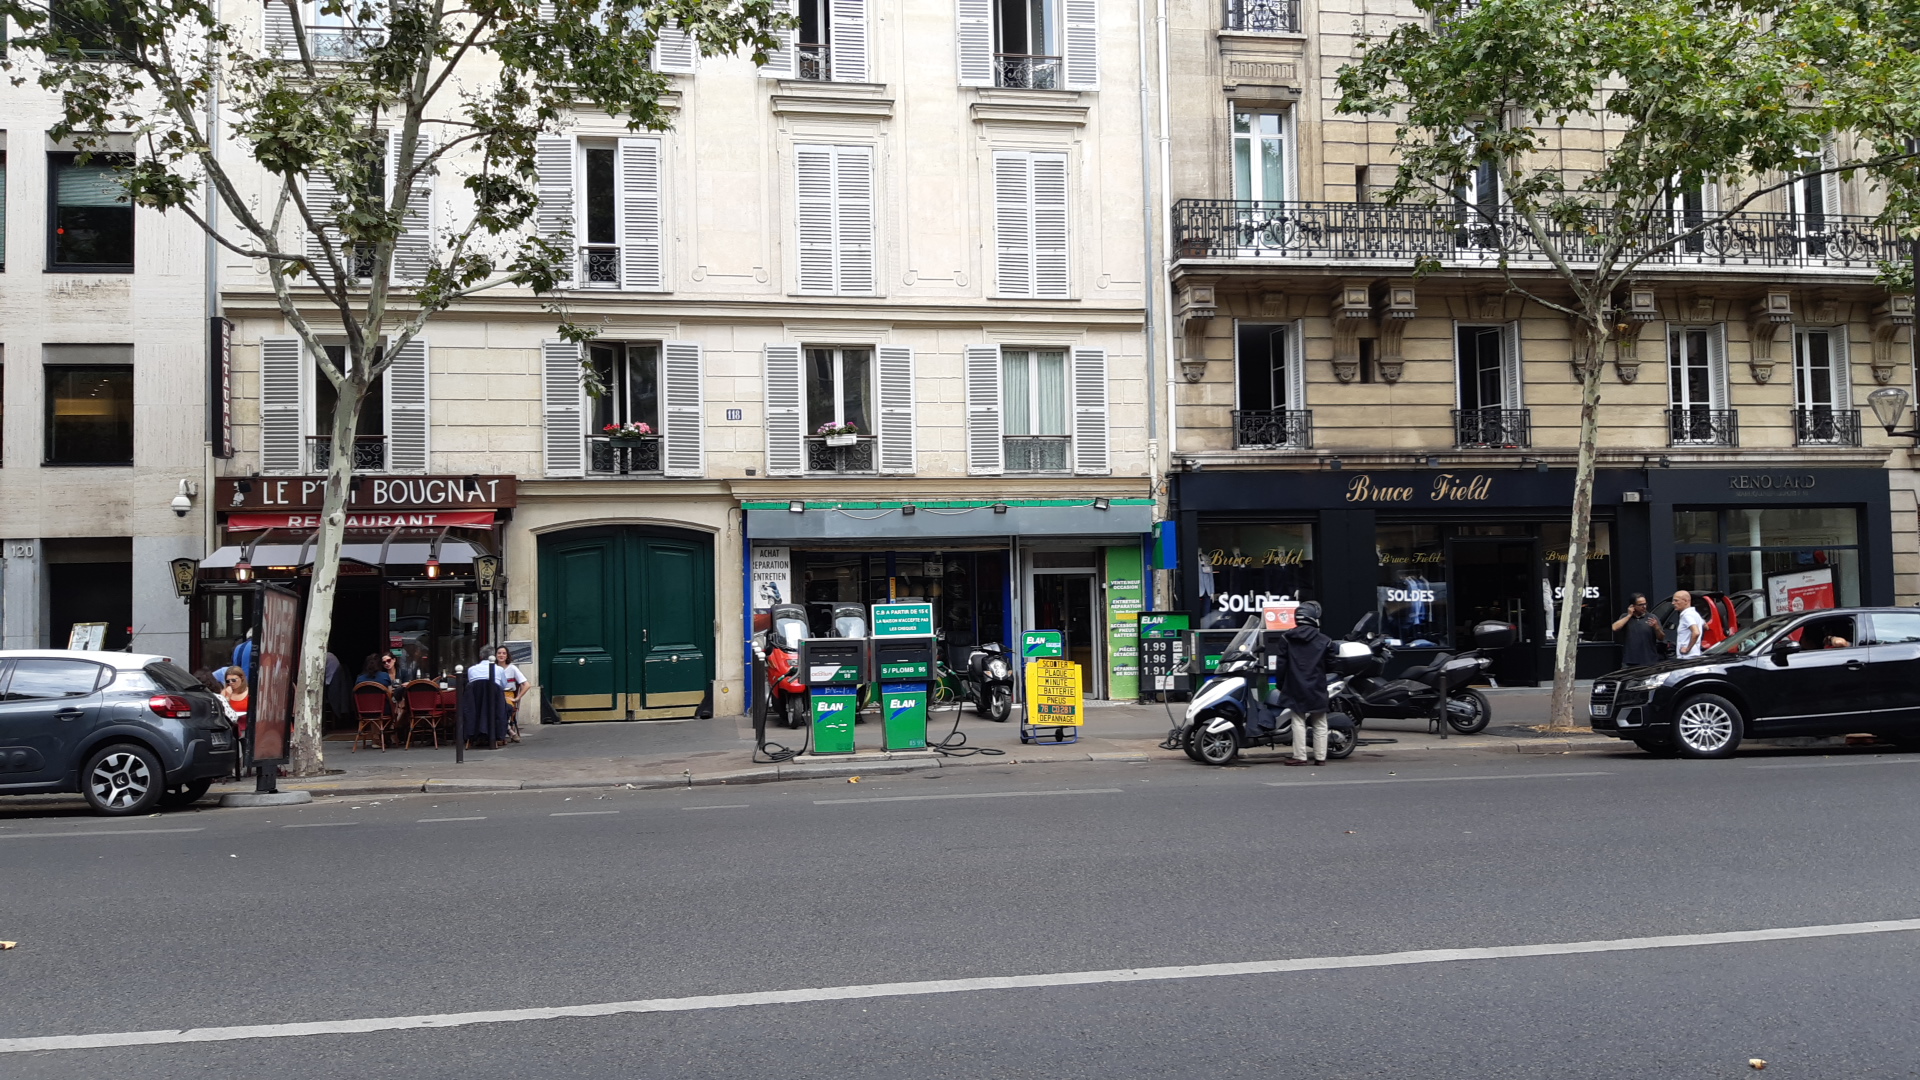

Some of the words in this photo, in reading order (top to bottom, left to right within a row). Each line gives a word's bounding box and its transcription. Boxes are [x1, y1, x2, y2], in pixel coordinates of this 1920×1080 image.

[222, 322, 232, 456] RESTAURANT
[727, 410, 741, 420] 118
[1729, 474, 1815, 489] RENOUARD
[263, 481, 289, 505] LE
[374, 478, 500, 505] BOUGNAT
[1346, 474, 1413, 502] Bruce
[1431, 473, 1492, 501] Field
[287, 514, 437, 527] REAURANT
[11, 545, 34, 558] 120
[760, 549, 779, 558] ACHAT
[1546, 551, 1569, 561] Bru
[1207, 548, 1253, 566] Bruce
[1262, 548, 1304, 565] Field
[1380, 552, 1410, 564] Bruce
[1412, 552, 1442, 563] Field
[753, 572, 787, 581] ENTRETIEN
[1387, 589, 1435, 602] SOLDES
[1141, 615, 1164, 624] ELAN
[1026, 636, 1046, 645] ELAN
[1143, 642, 1167, 652] 1.99
[1042, 660, 1069, 668] SCOOTER
[1143, 654, 1167, 664] 1.96
[1045, 669, 1068, 678] PLAQUE
[1143, 666, 1166, 676] 1.91
[1045, 678, 1068, 687] MINUTE
[1043, 687, 1074, 696] BATTERIE
[890, 699, 915, 709] ELAN
[1047, 696, 1067, 705] PNEUS
[817, 701, 844, 712] ELAN
[1039, 715, 1074, 723] DEPANNAGE
